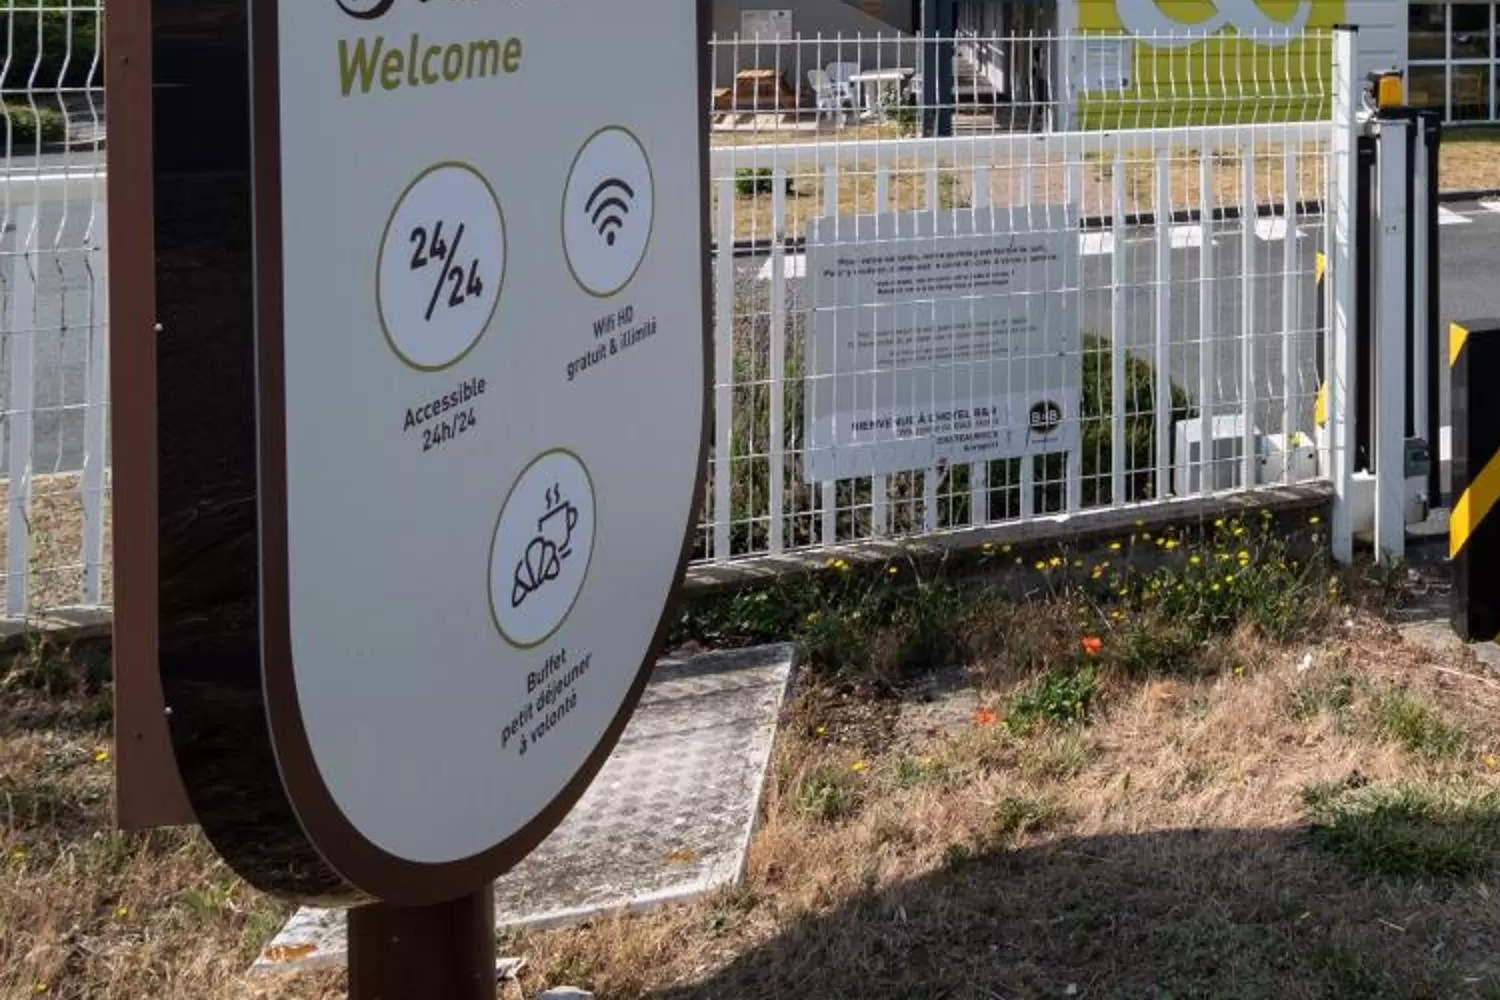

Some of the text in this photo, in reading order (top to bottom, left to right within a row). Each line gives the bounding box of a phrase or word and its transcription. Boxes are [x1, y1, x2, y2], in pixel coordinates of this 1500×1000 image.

[337, 33, 523, 97] Welcome
[592, 313, 616, 339] Wifi
[567, 344, 606, 381] gratuit
[403, 377, 486, 433] Accessible
[423, 407, 477, 452] 24h/24
[527, 648, 566, 694] Buffet
[502, 652, 592, 750] petit déjeuner
[531, 688, 576, 743] volonté
